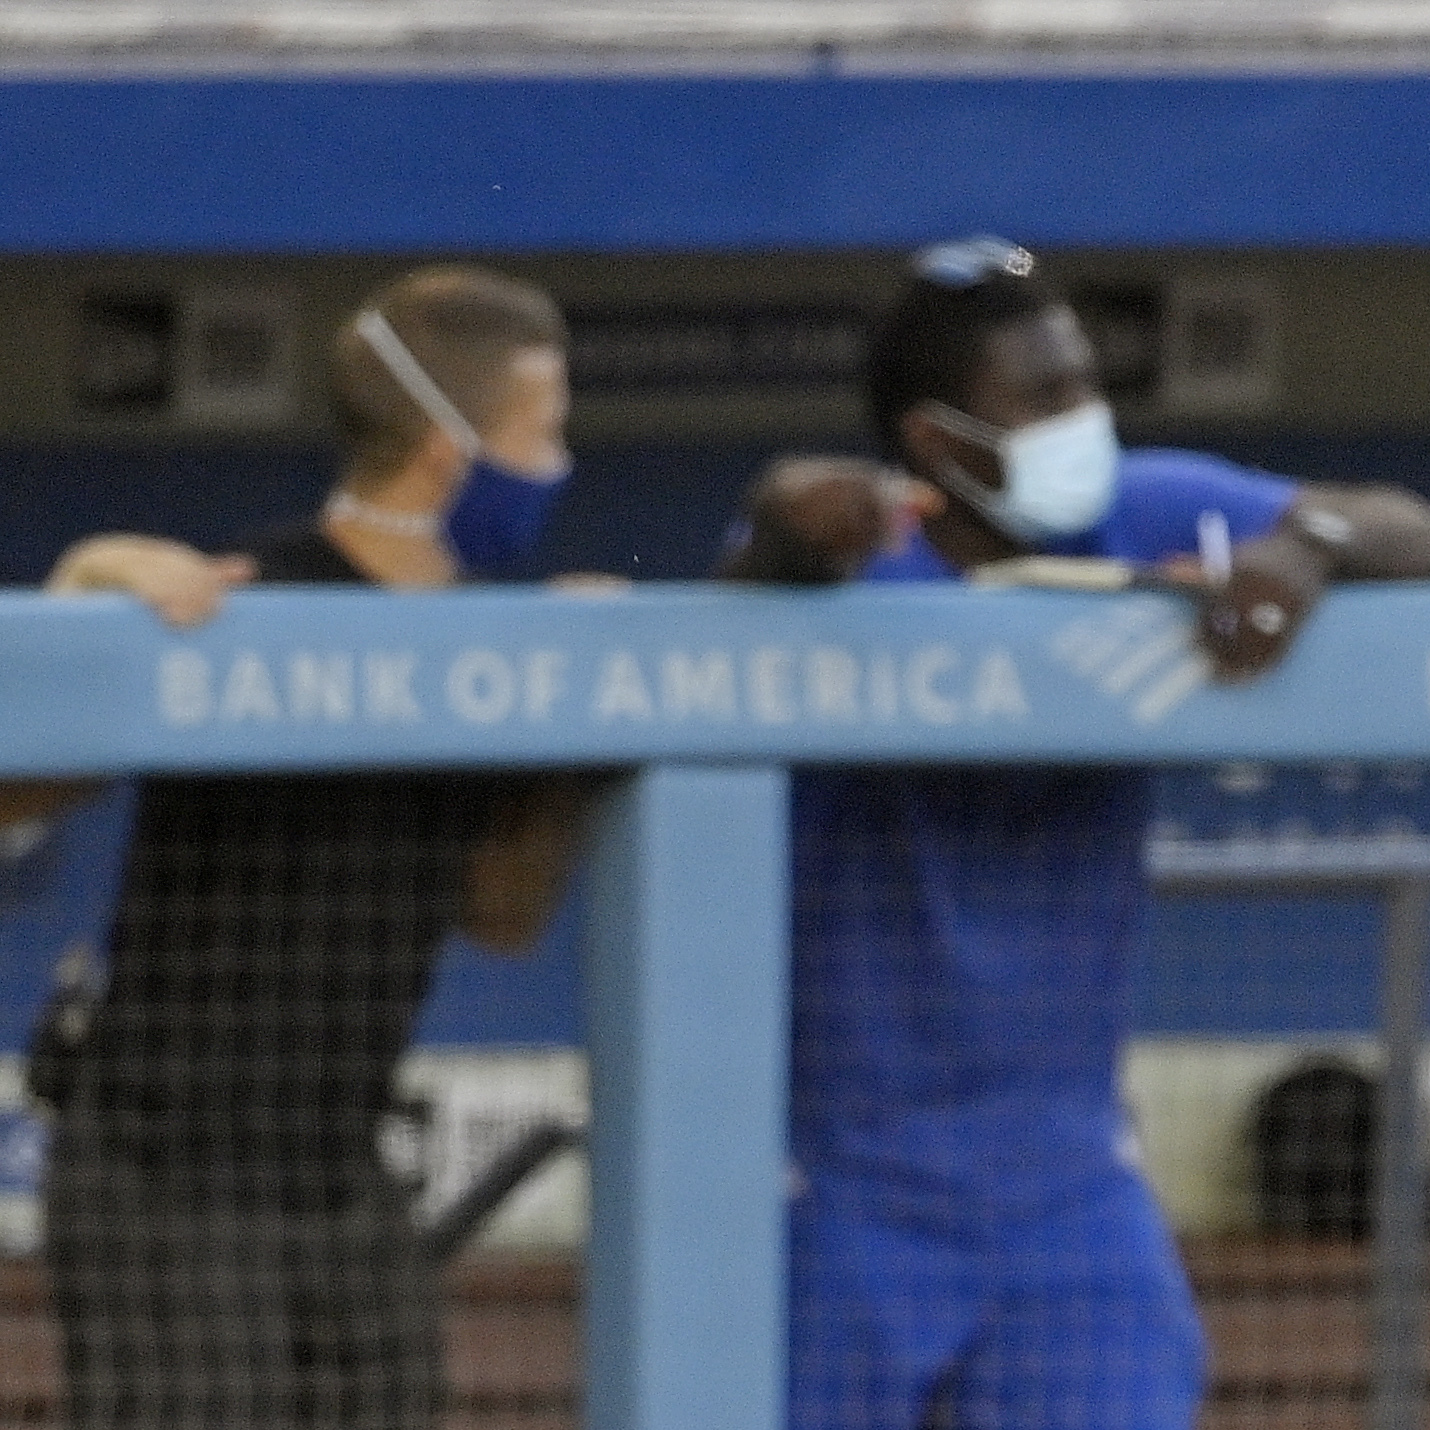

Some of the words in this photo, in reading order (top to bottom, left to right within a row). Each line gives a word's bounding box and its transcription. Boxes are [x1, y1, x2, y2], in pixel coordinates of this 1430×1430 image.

[156, 646, 420, 726] BANK
[446, 646, 570, 724] OF
[590, 644, 1030, 726] AMERICA
